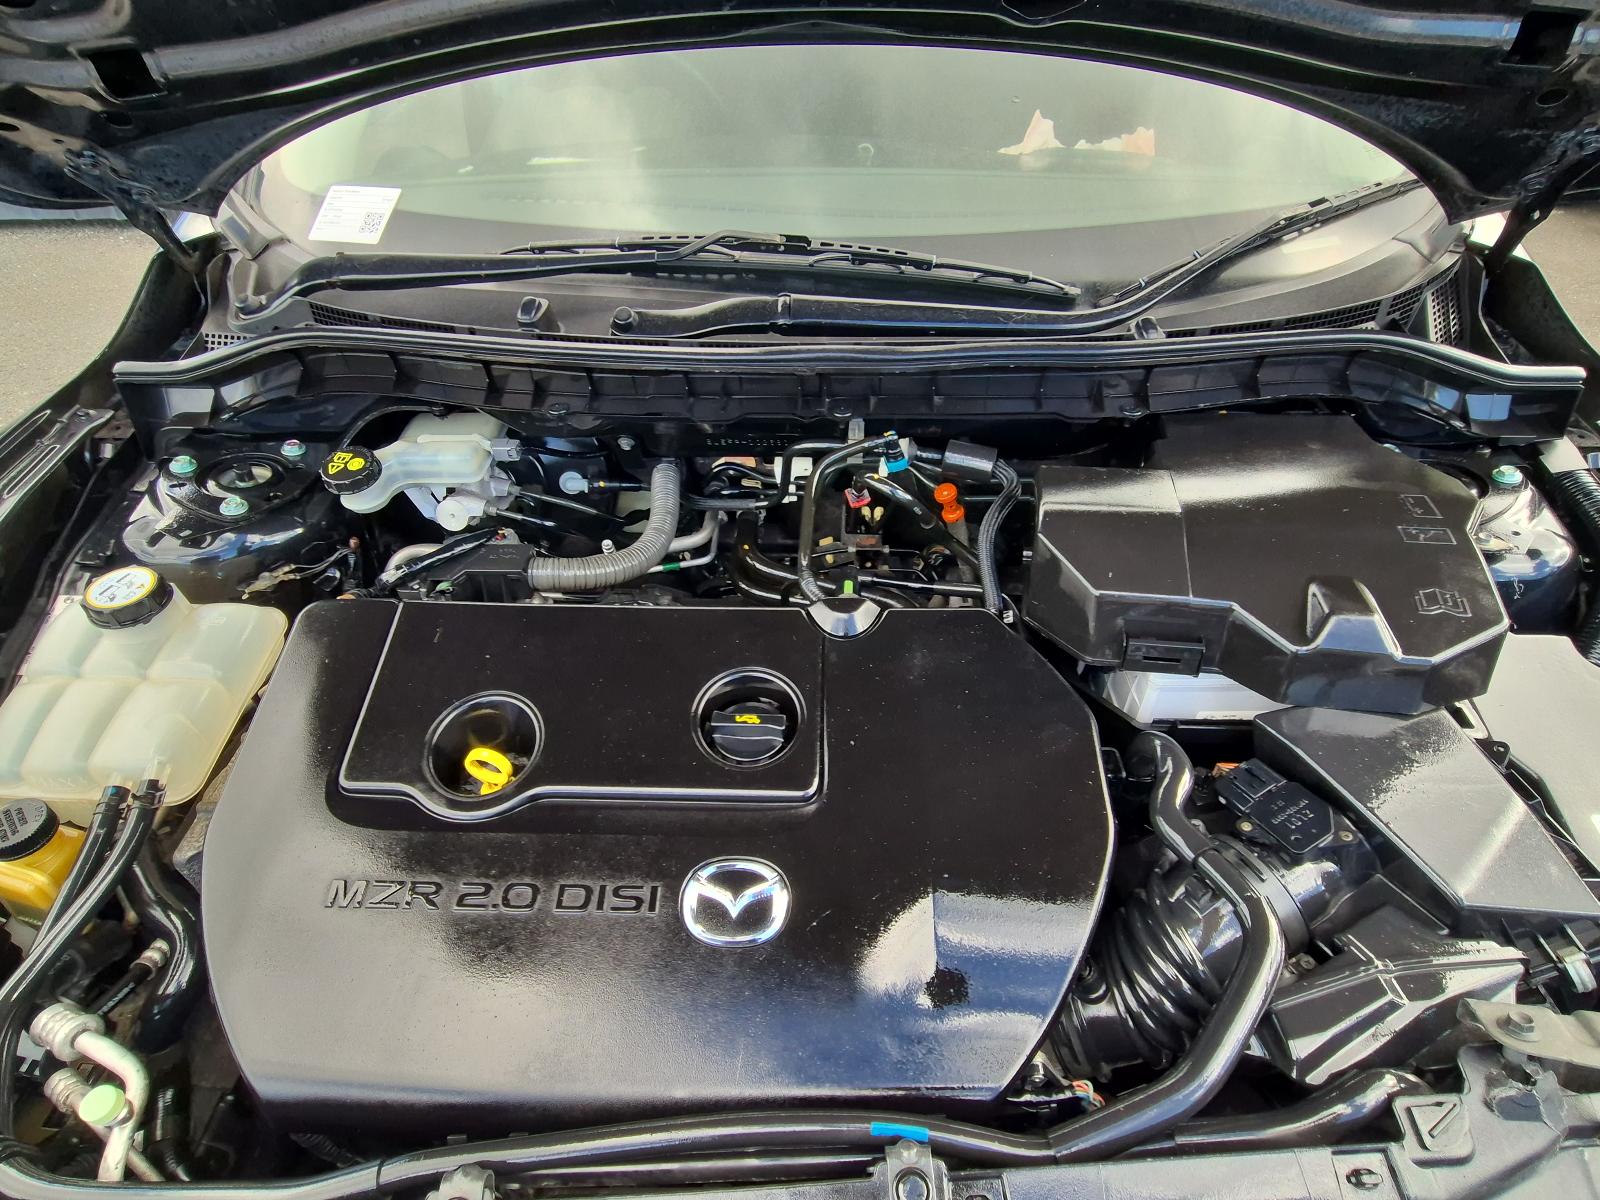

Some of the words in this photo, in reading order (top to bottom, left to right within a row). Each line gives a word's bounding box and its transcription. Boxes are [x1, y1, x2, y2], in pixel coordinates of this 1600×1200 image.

[325, 879, 443, 910] MZR
[454, 881, 541, 914] 2.0
[554, 882, 661, 915] DISI
